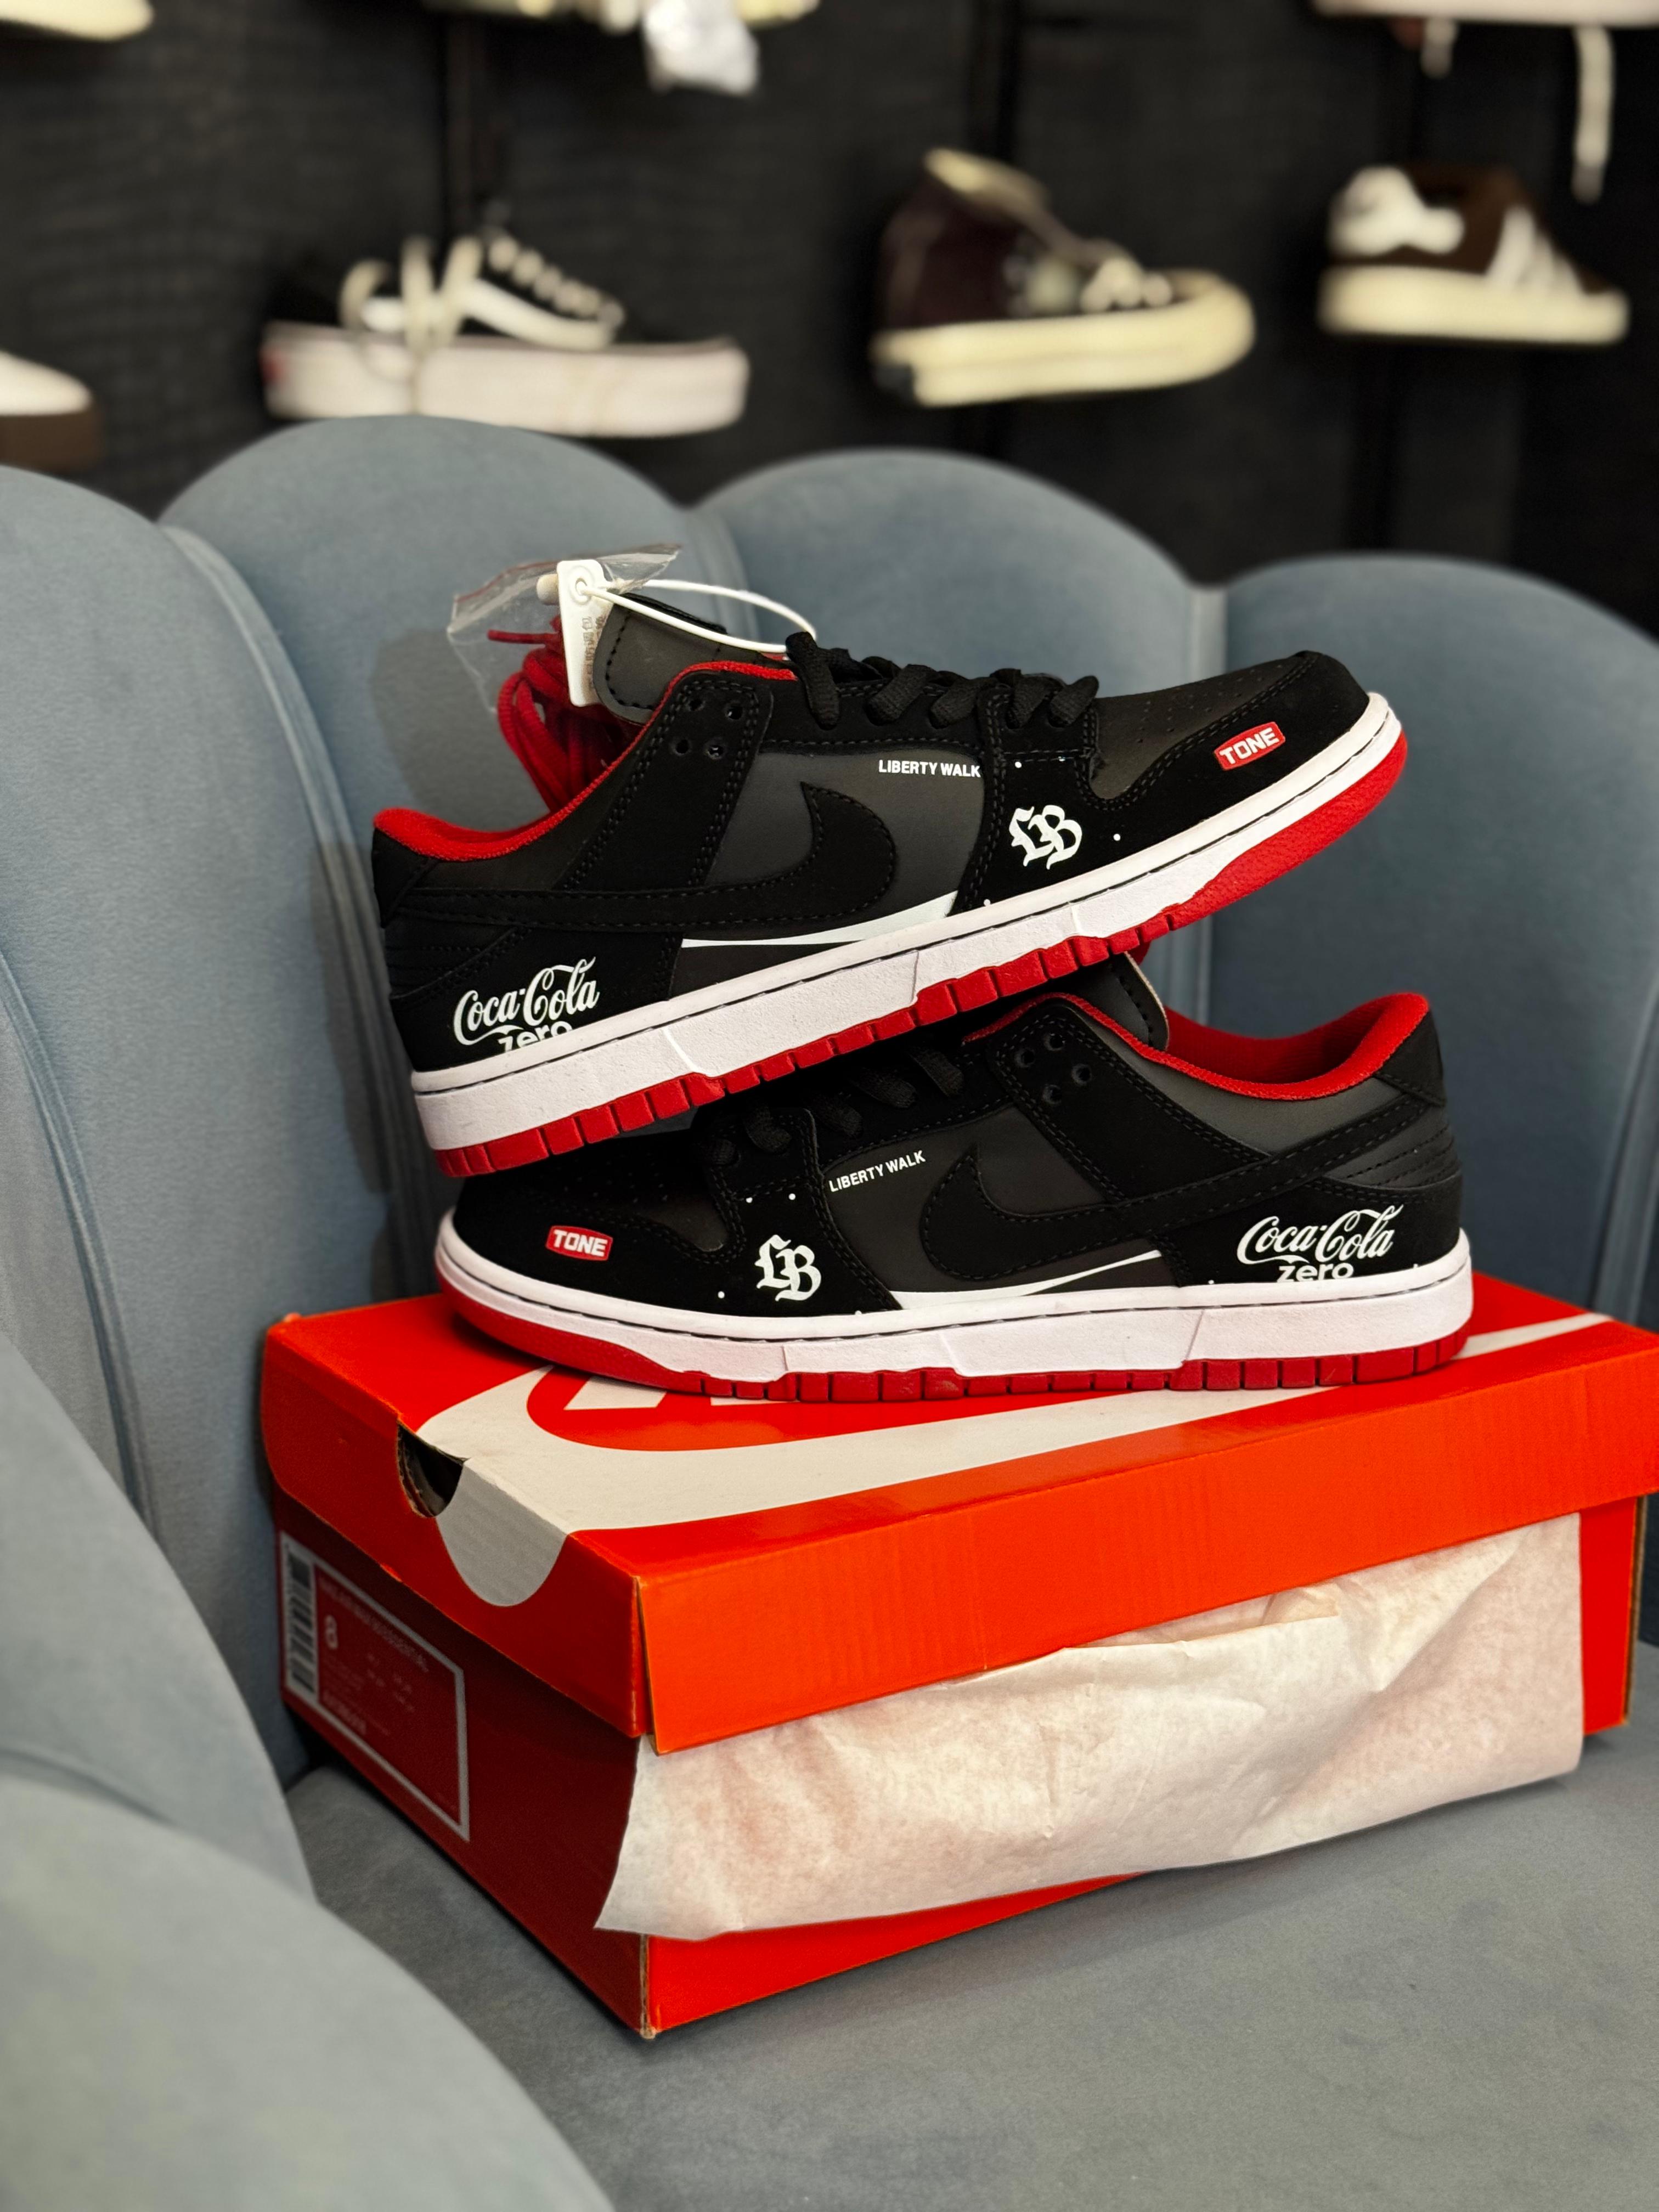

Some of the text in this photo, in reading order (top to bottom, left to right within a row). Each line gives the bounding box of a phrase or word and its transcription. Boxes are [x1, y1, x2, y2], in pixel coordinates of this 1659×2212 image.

[1219, 727, 1279, 764] TONE
[878, 759, 981, 778] LIBERTY WALK
[454, 957, 600, 1046] Coca-Cola
[829, 1150, 926, 1192] LIBERTY WALK
[553, 1229, 607, 1257] TONE
[1237, 1204, 1404, 1265] Coca-Cola
[1277, 1262, 1354, 1283] zero
